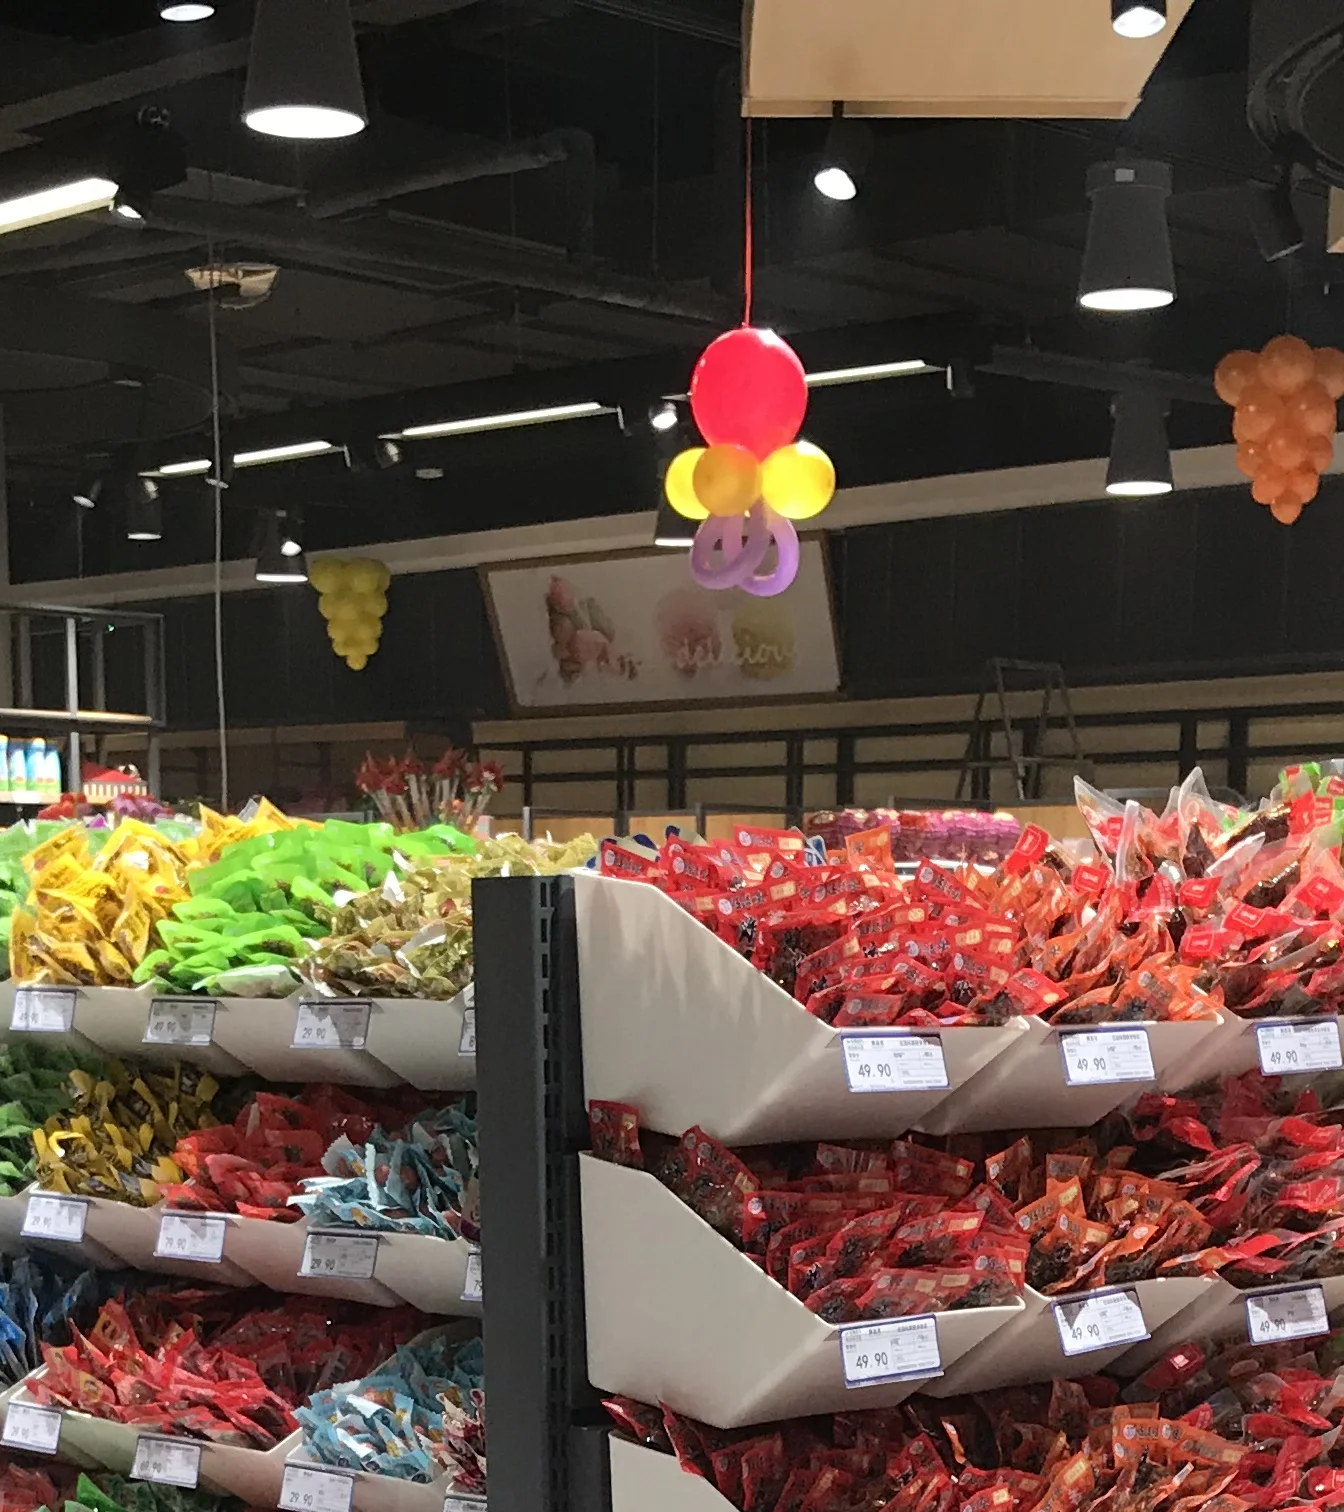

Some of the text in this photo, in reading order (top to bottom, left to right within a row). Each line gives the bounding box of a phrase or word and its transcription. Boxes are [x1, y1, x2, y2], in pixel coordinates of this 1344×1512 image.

[1077, 1056, 1106, 1071] 49.90
[1270, 1050, 1298, 1064] 49.90
[858, 1063, 891, 1078] 49.90
[1072, 1324, 1100, 1340] 49.90
[1260, 1319, 1286, 1333] 49.90
[856, 1352, 888, 1368] 49.90
